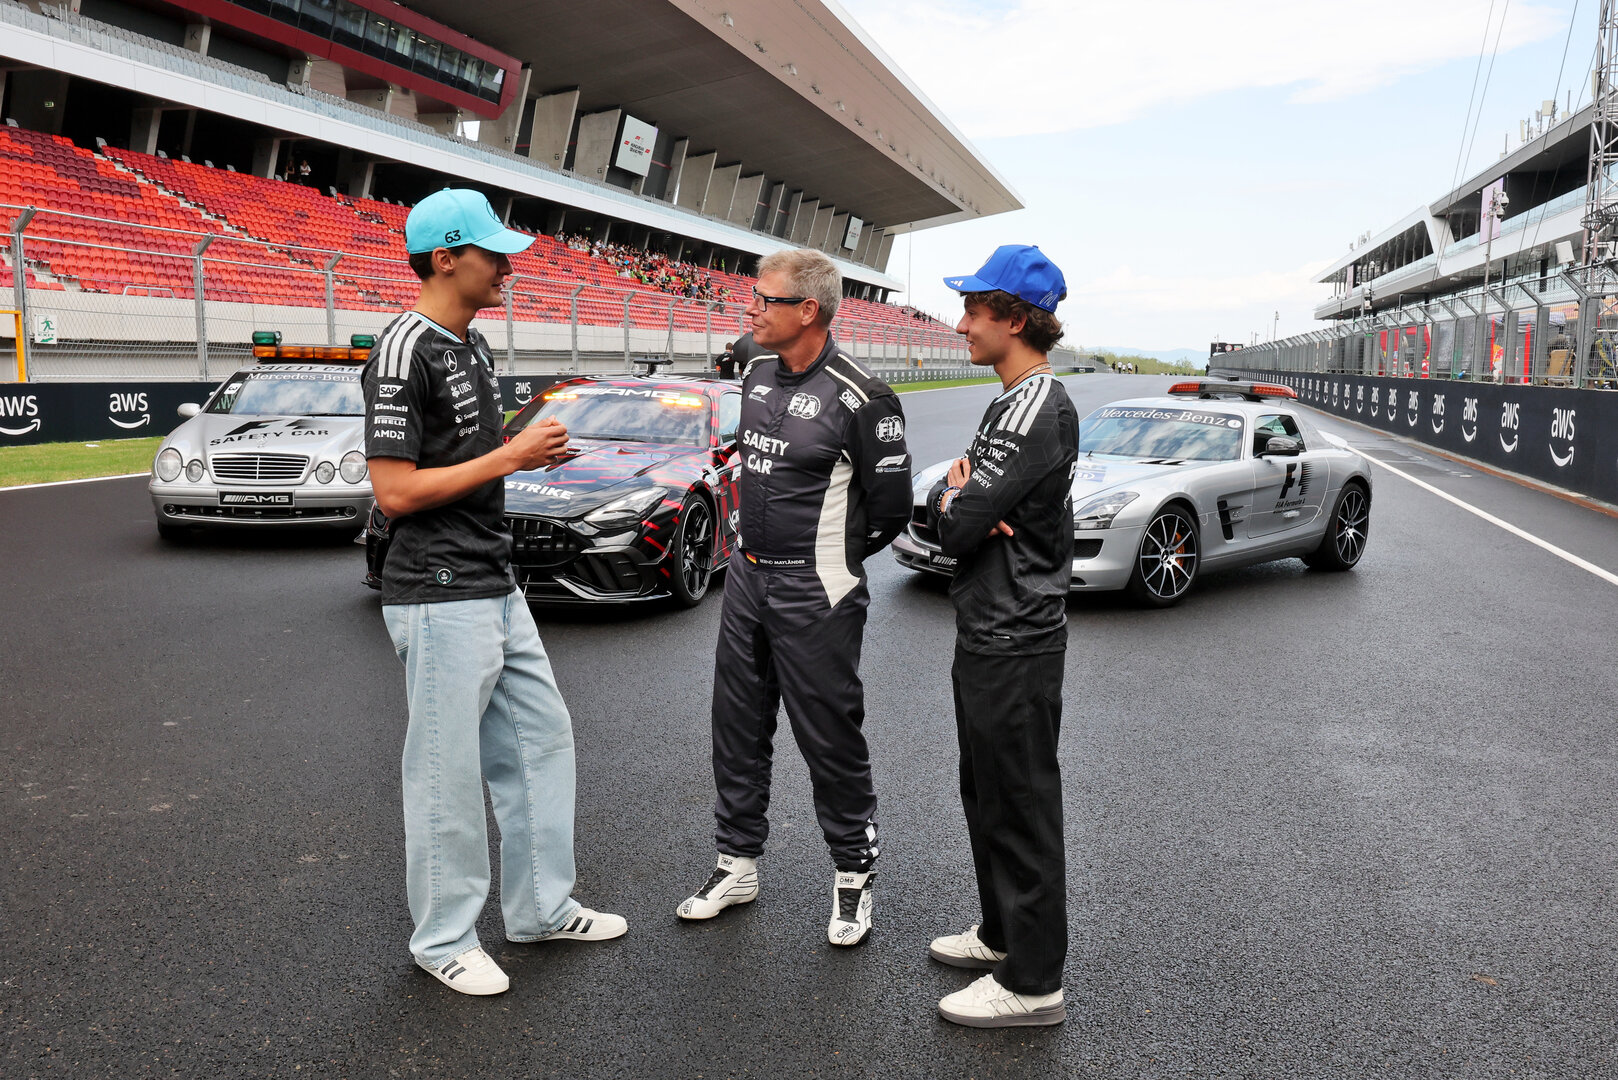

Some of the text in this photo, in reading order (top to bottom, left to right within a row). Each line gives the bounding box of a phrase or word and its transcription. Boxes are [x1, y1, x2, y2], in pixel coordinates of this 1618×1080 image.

[445, 230, 461, 243] 63
[246, 373, 360, 383] Mercedes-Benz
[380, 386, 398, 395] SAP
[458, 381, 473, 394] UBS
[515, 381, 532, 394] aws
[602, 388, 681, 398] AMG
[109, 392, 149, 413] aws
[374, 403, 408, 412] Einhell
[789, 395, 818, 417] FIA
[841, 390, 862, 410] OMP
[1433, 393, 1445, 416] aws
[1097, 408, 1227, 426] Mercedes-Benz
[1463, 397, 1478, 422] aws
[1501, 401, 1520, 430] aws
[374, 415, 407, 427] PIRELLI
[1551, 407, 1576, 441] aws
[374, 430, 397, 439] AMD
[877, 420, 904, 439] FIA
[210, 431, 284, 446] SAFETY
[987, 447, 1008, 462] IWC
[747, 454, 773, 475] CAR
[242, 494, 289, 503] AMG
[837, 925, 854, 939] OMP
